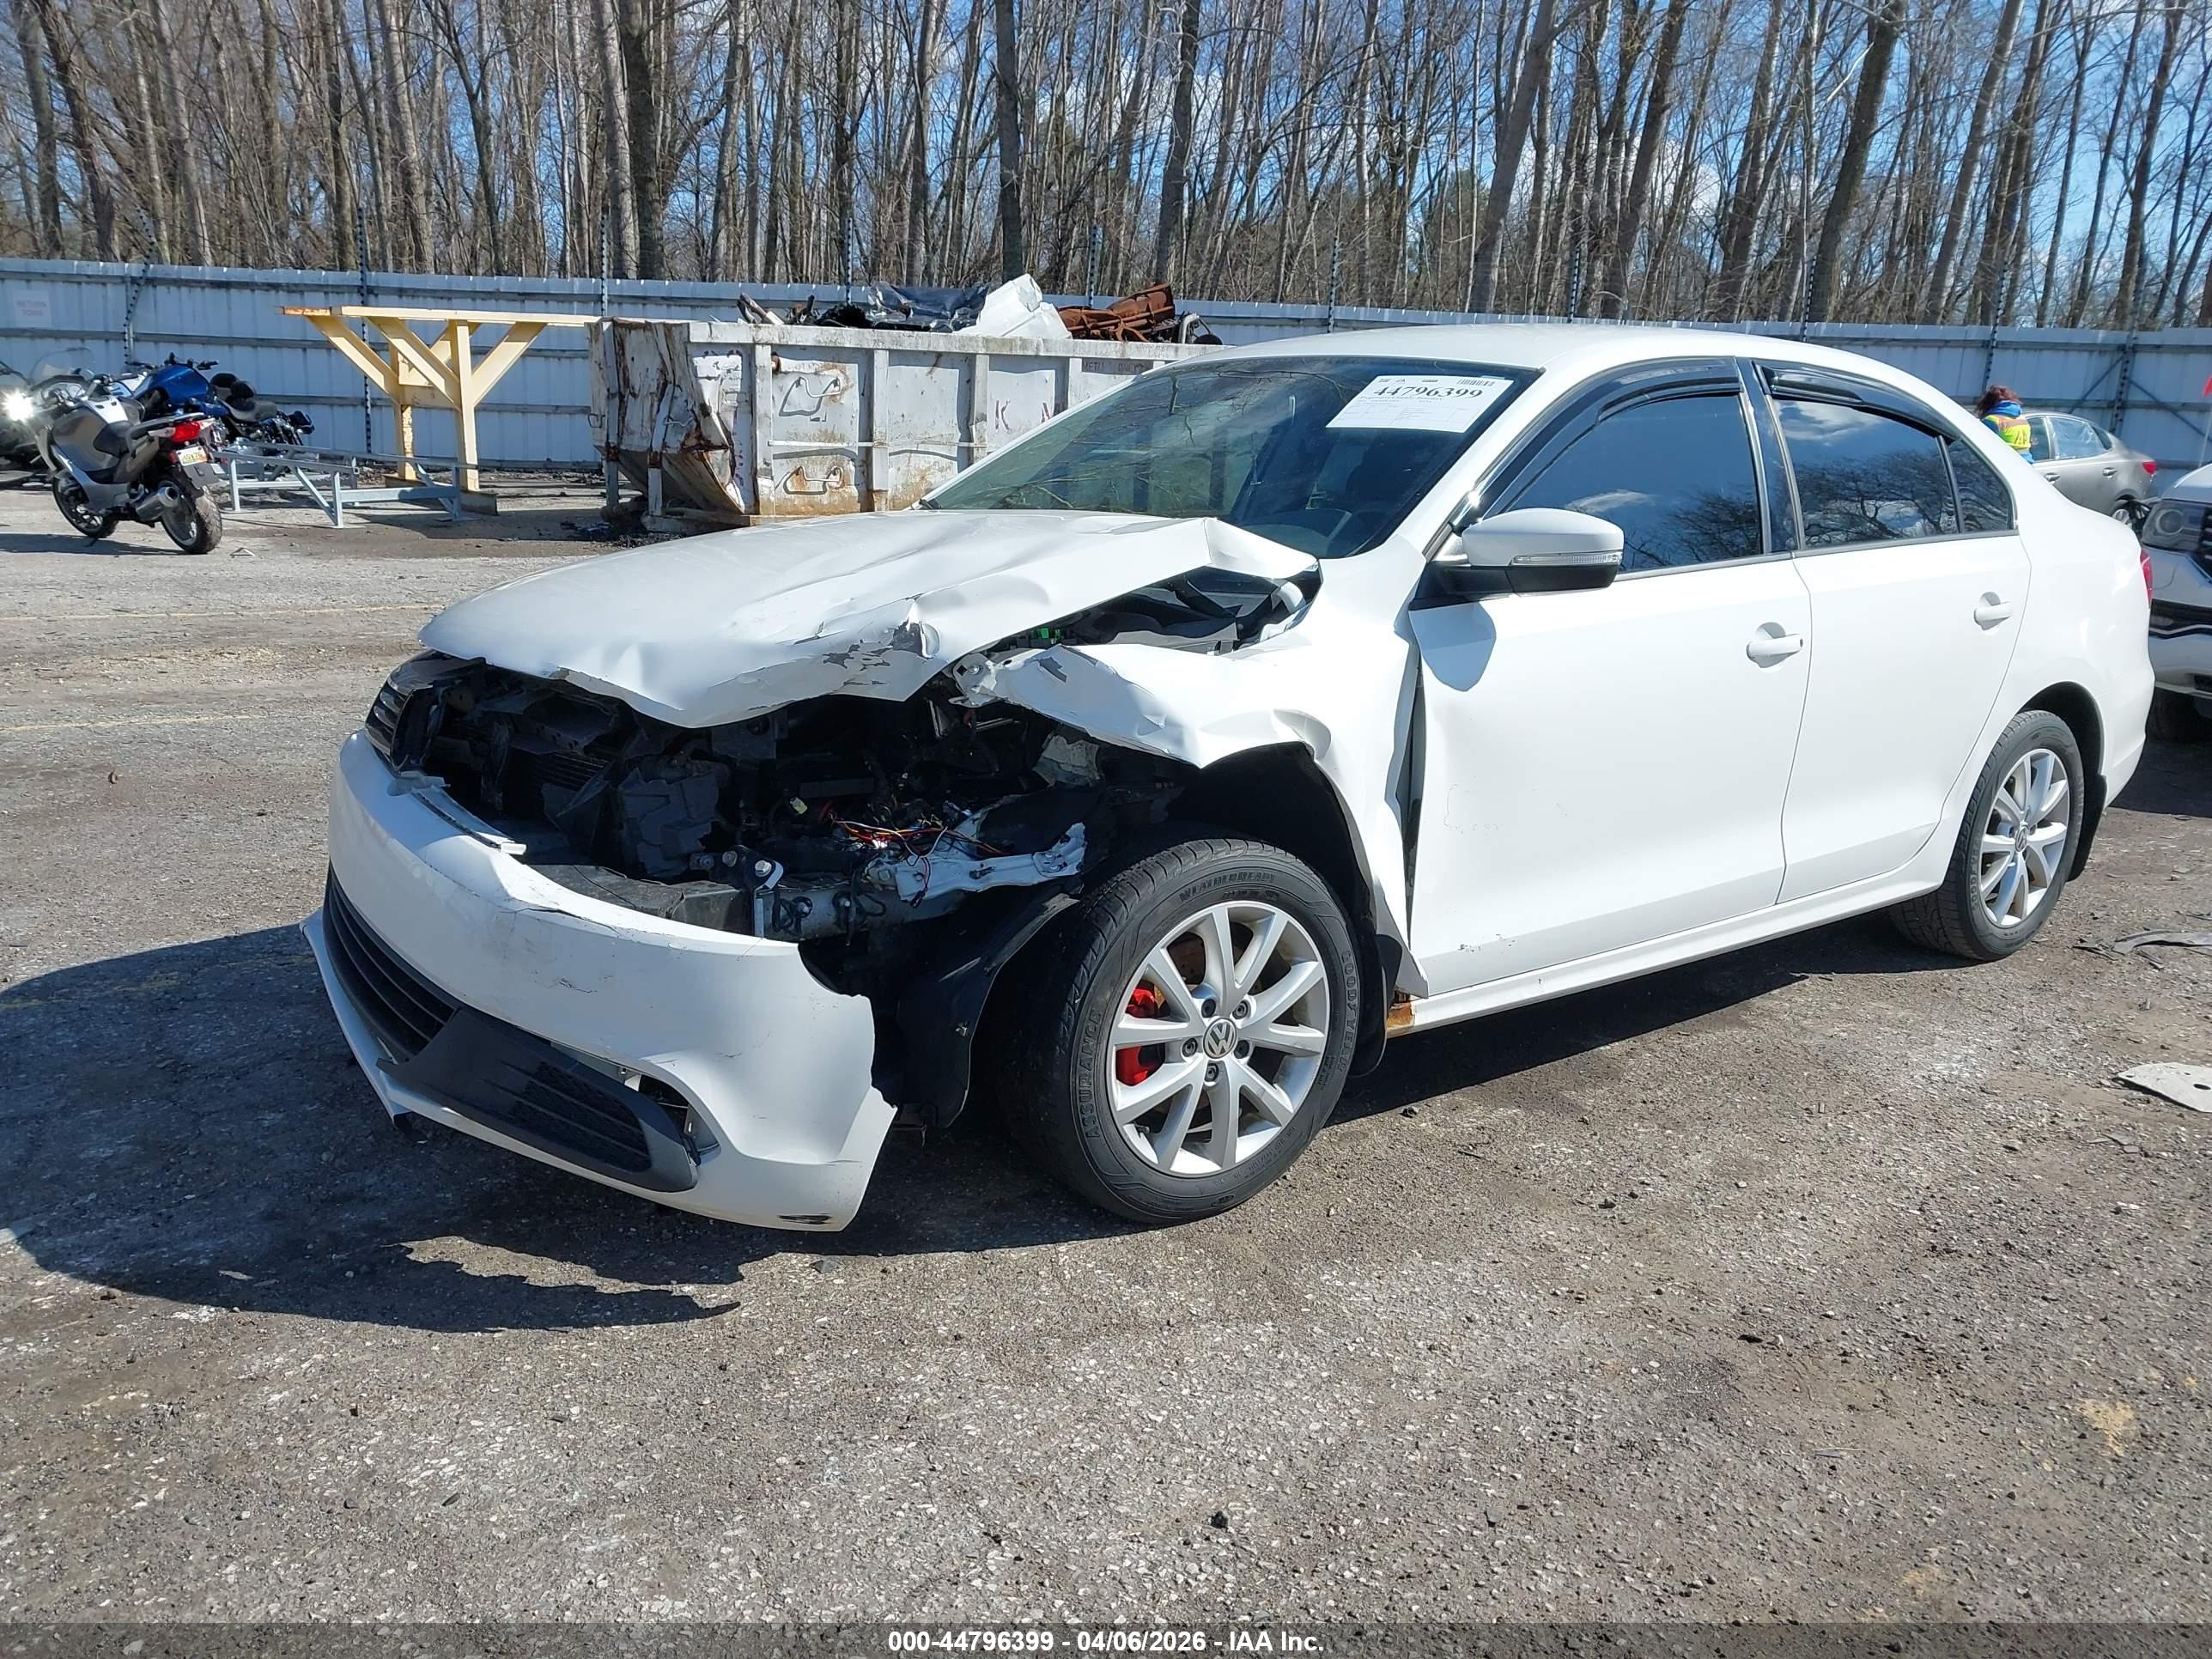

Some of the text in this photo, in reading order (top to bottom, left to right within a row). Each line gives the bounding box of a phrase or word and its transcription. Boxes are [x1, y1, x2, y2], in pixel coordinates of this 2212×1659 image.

[1374, 386, 1483, 398] 44796399
[1206, 1019, 1235, 1057] VW
[1338, 950, 1358, 1073] GOODYEAR
[1079, 1009, 1103, 1139] ASSURANCE
